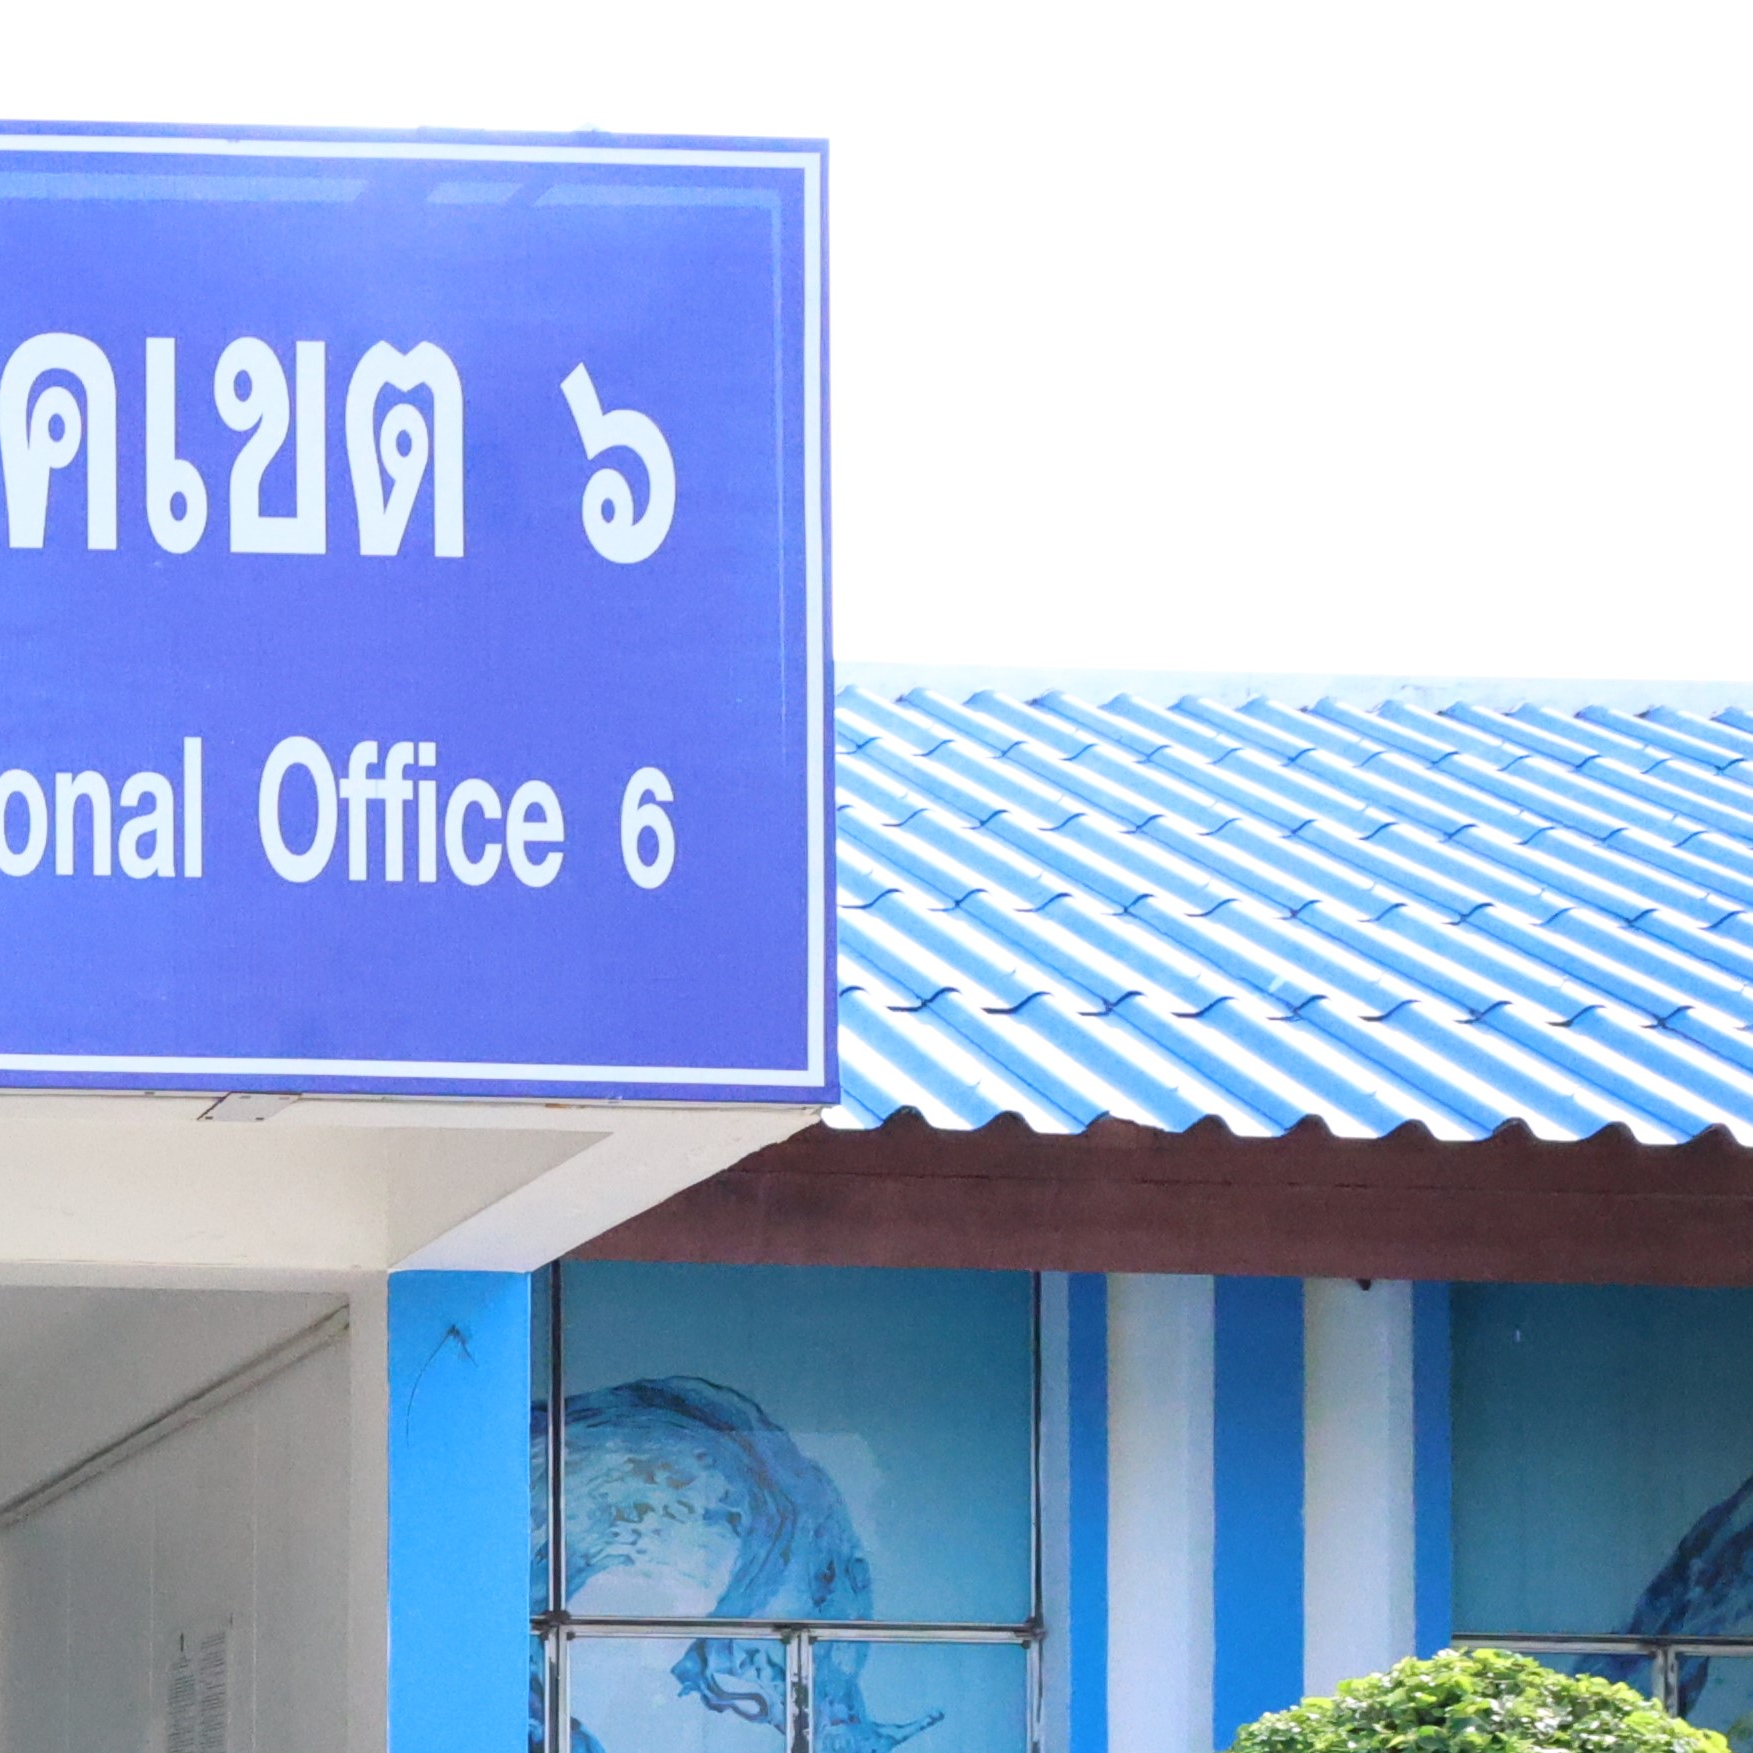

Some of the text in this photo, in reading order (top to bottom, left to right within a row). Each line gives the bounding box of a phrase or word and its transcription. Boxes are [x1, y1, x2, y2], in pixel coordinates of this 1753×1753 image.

[560, 362, 676, 564] ๖
[258, 735, 565, 888] Office
[620, 766, 675, 890] 6
